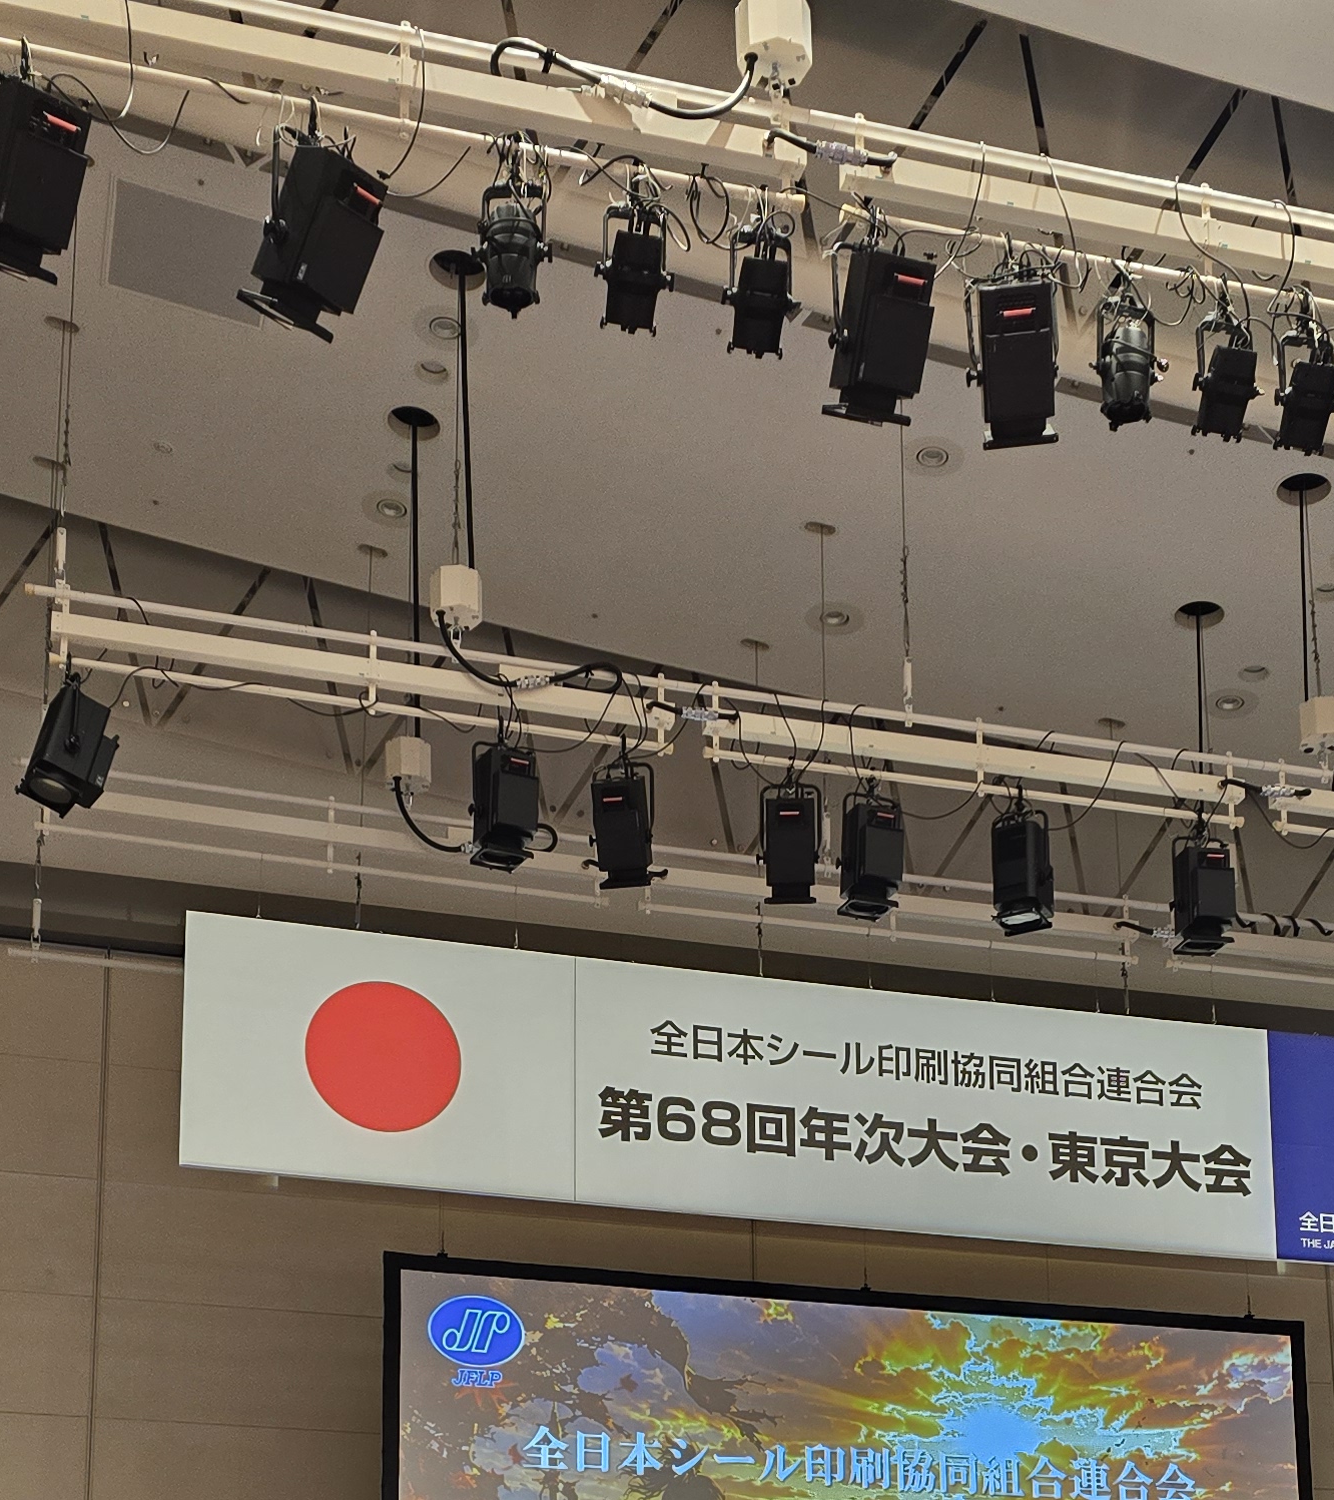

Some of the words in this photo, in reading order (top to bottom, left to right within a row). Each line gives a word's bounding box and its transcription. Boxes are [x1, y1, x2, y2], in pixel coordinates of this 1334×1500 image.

[650, 1020, 1203, 1109] 全日本シール印刷協同組合連合会
[1300, 1238, 1322, 1249] THE
[451, 1369, 502, 1388] JFLP
